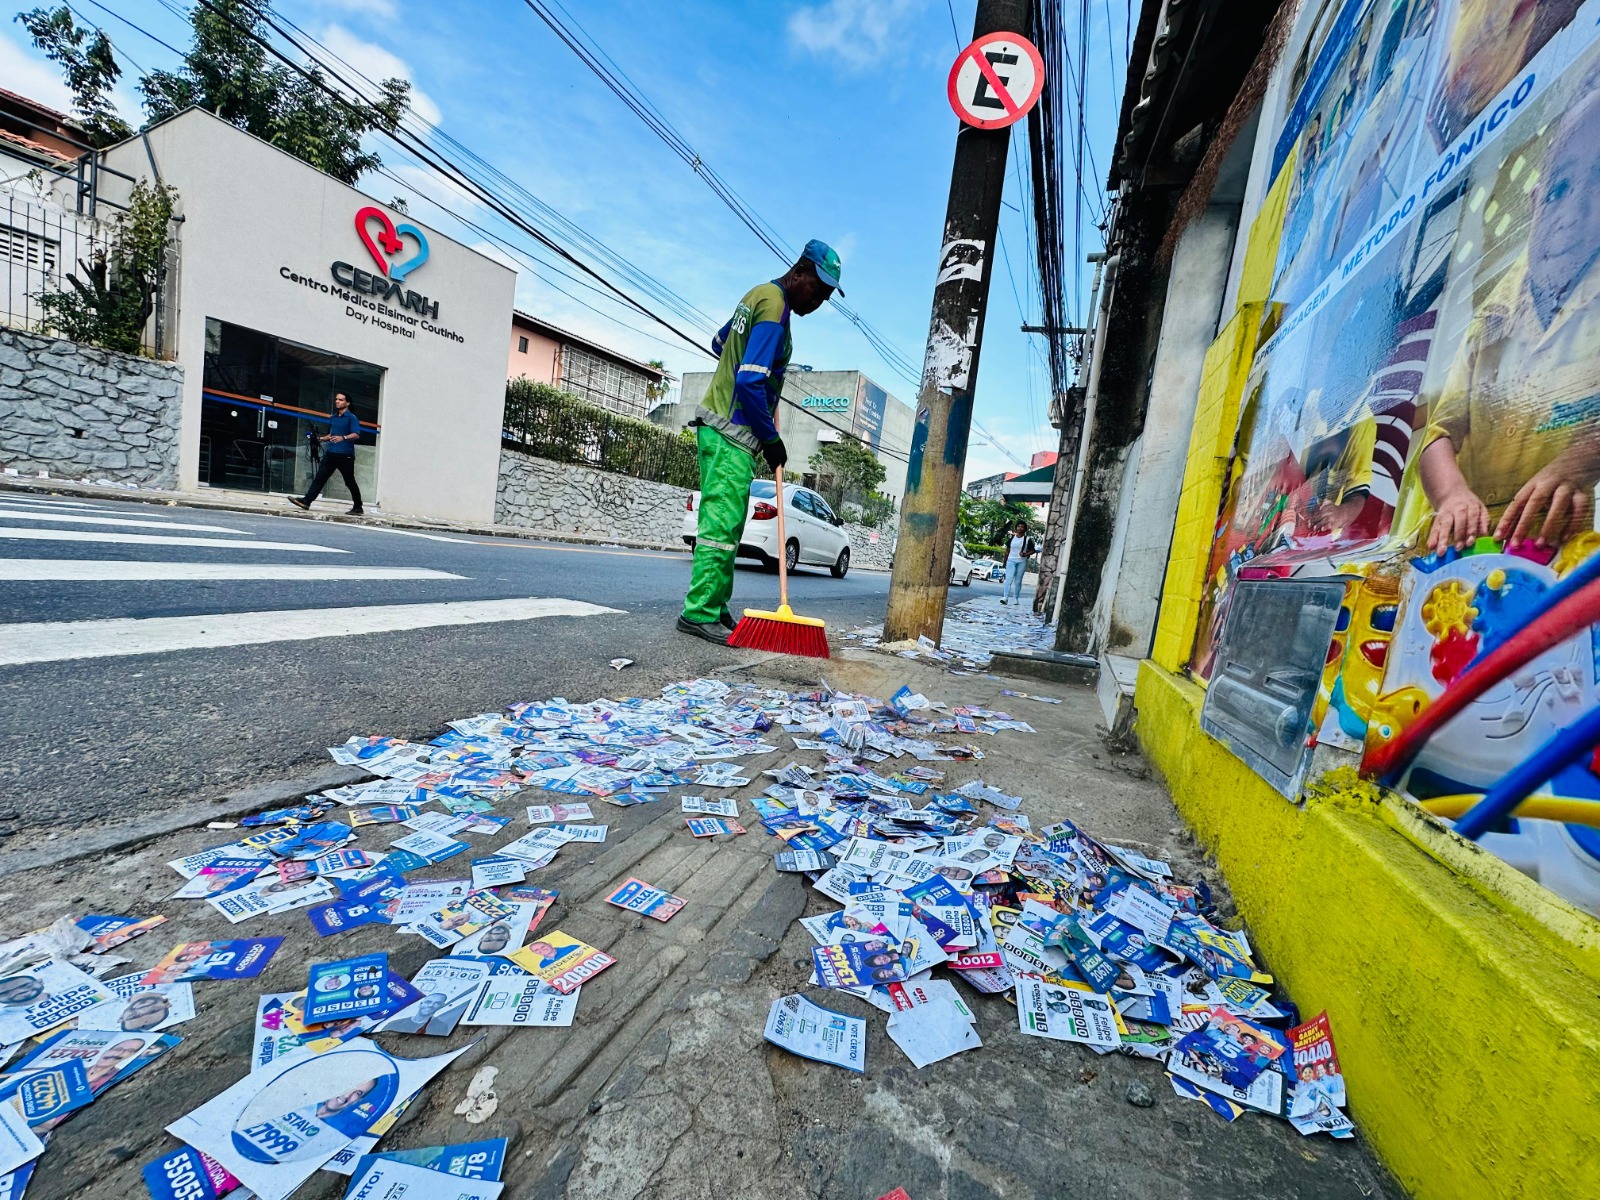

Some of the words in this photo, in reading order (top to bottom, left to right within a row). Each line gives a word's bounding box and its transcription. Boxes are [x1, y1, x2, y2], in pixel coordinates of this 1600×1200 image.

[971, 52, 1019, 110] E
[1341, 194, 1417, 280] MÉTODO
[1422, 73, 1536, 200] FÔNICO
[331, 260, 440, 320] CEPARH
[279, 266, 329, 294] Centro
[330, 284, 377, 312] Médico
[377, 305, 420, 328] Elsimar
[420, 320, 465, 344] Coutinho
[345, 306, 370, 325] Day
[371, 314, 416, 340] Hospital
[866, 904, 884, 912] 558
[33, 960, 54, 973] psd
[204, 951, 237, 968] 15
[552, 952, 610, 994] 20800
[814, 947, 840, 986] MARTA
[831, 944, 859, 986] 13456
[106, 971, 149, 989] 800
[24, 983, 92, 1015] Felipe
[24, 989, 98, 1022] Santana
[513, 979, 540, 1022] 55800
[543, 997, 555, 1021] Santana
[550, 999, 565, 1022] Felipe
[33, 999, 94, 1029] 55800
[775, 1009, 787, 1036] 20678
[1037, 1012, 1049, 1033] 15
[1069, 990, 1089, 1039] 55800
[1092, 1012, 1103, 1041] Santana
[850, 1023, 859, 1038] VOTE
[1100, 1016, 1112, 1042] Felipe
[848, 1038, 858, 1061] CERTO!
[1213, 1040, 1241, 1059] 15
[282, 1112, 320, 1137] STAVO
[449, 1155, 467, 1176] AR
